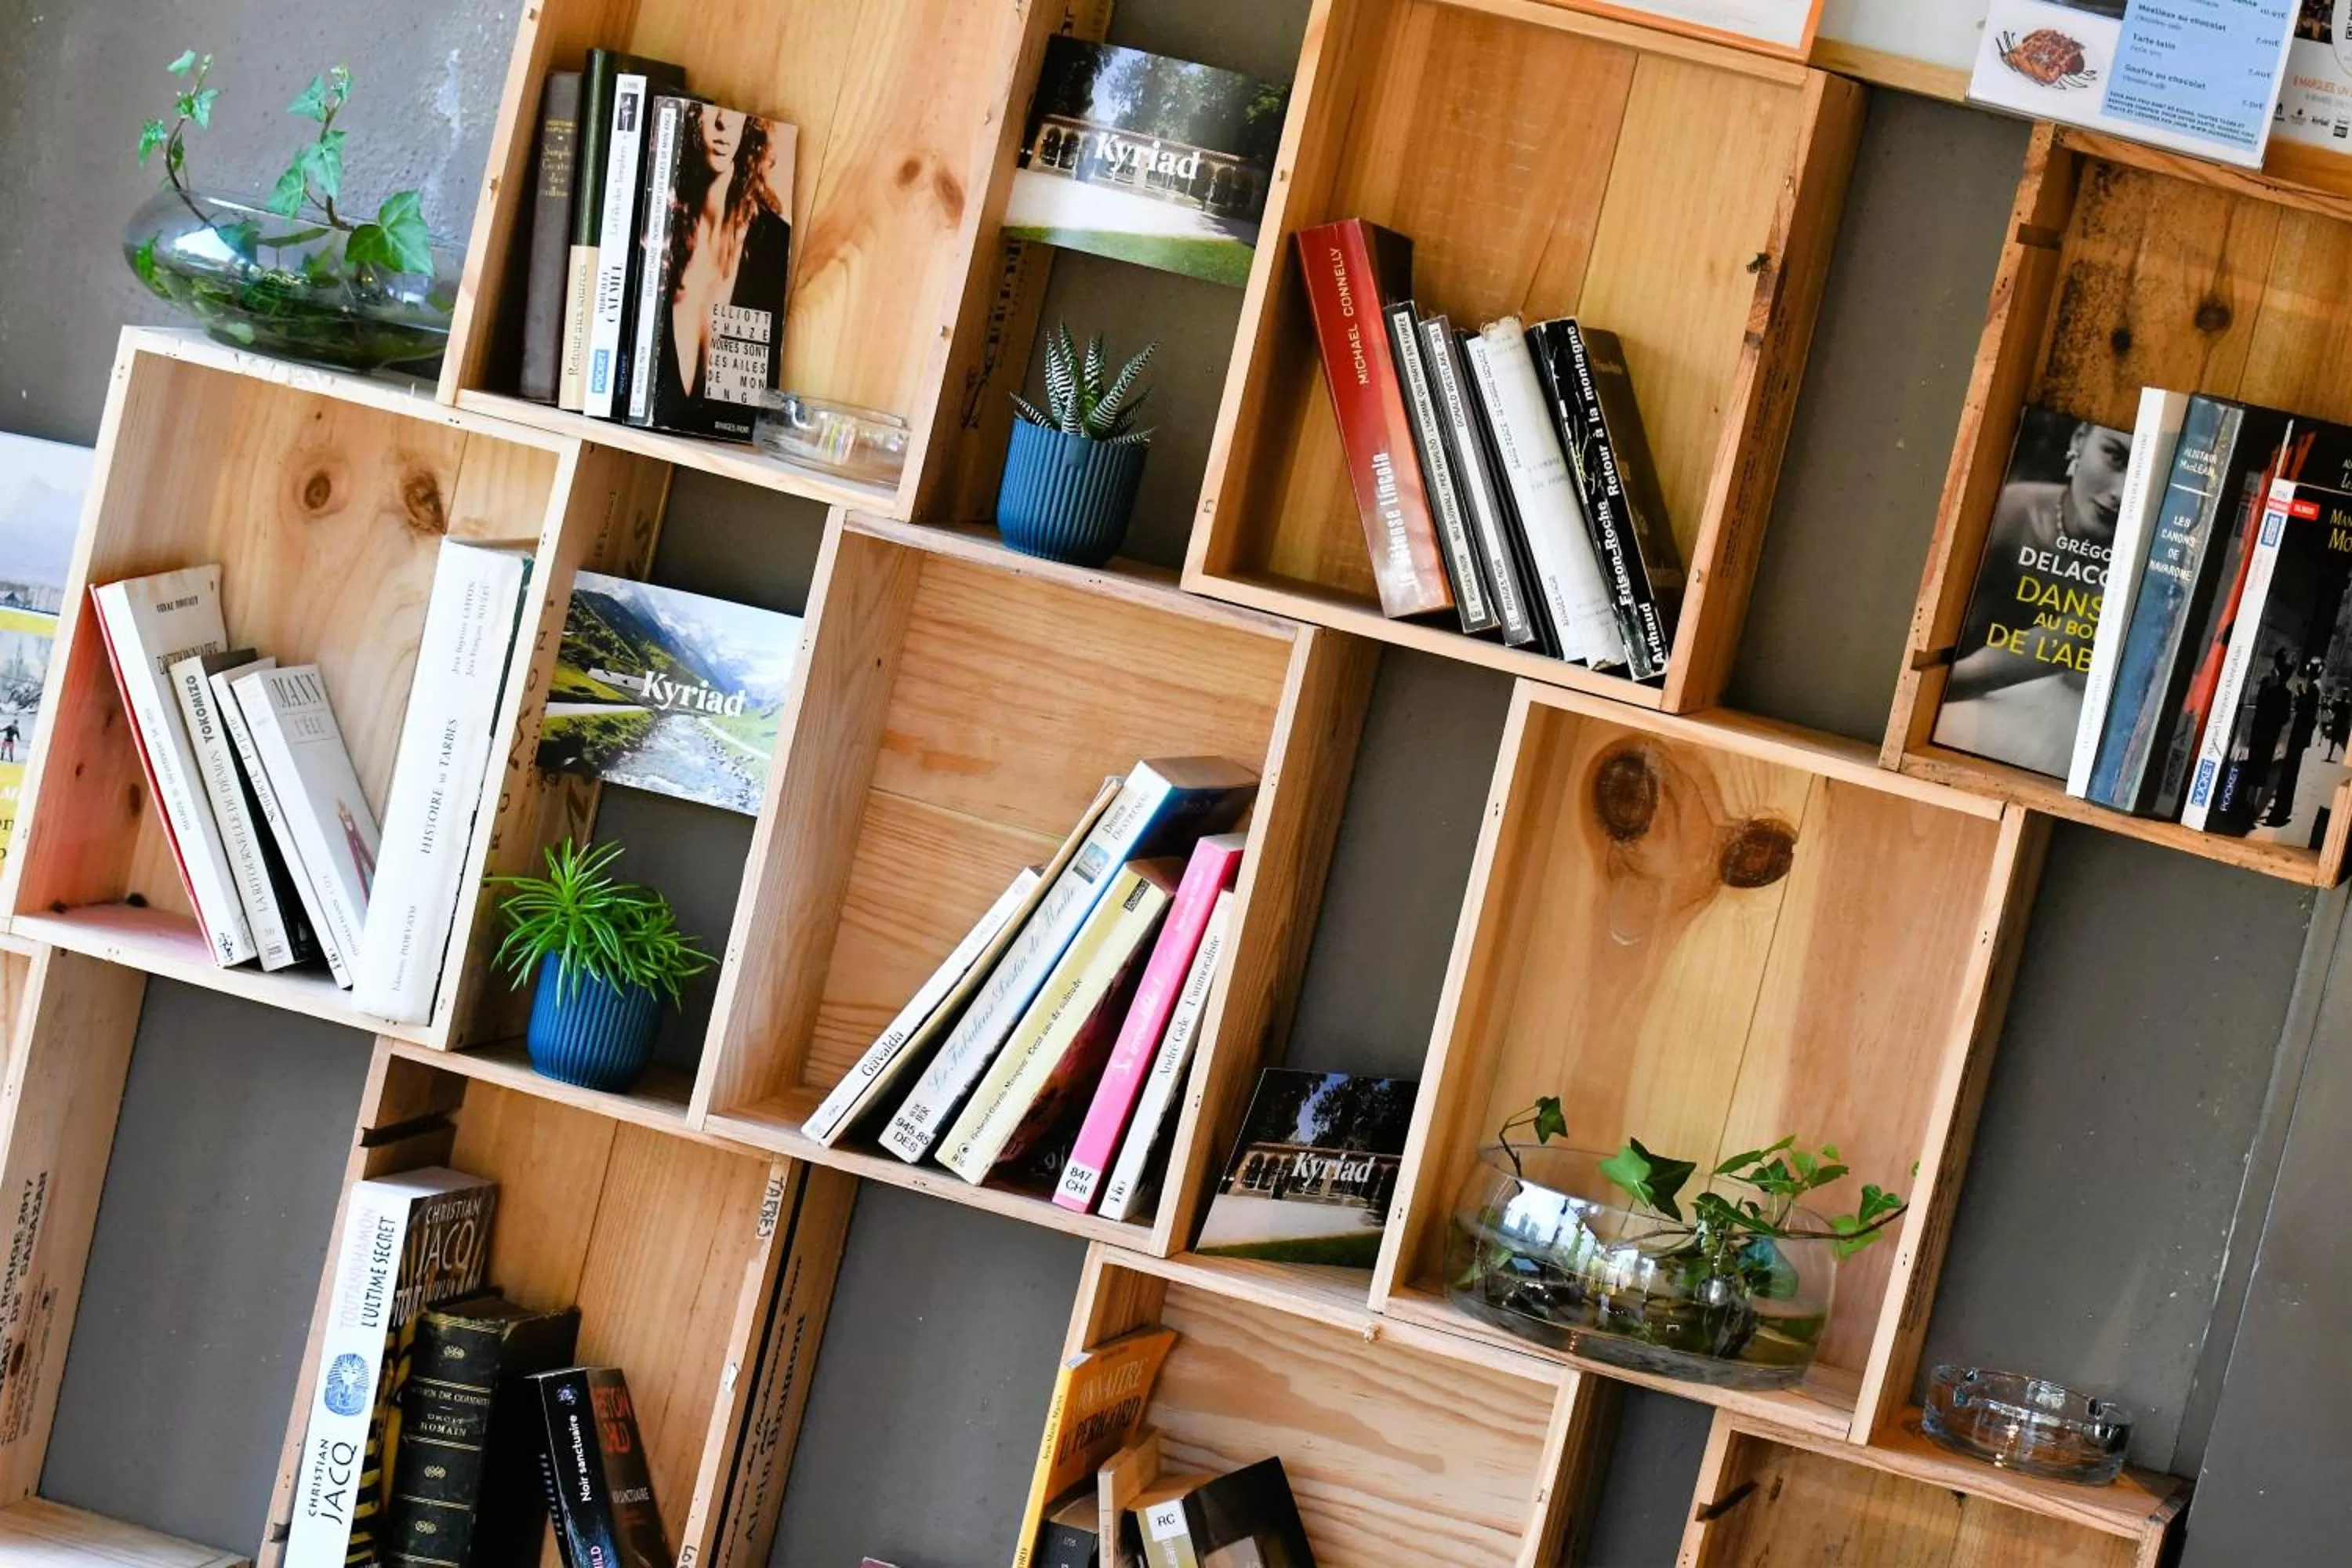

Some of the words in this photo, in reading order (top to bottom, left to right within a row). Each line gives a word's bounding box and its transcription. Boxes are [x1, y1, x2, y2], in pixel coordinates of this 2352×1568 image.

[1094, 132, 1200, 179] Kyriad
[1330, 246, 1354, 318] CONNELLY
[711, 320, 770, 341] CHAZE
[713, 303, 770, 325] ELLIOTT
[568, 335, 583, 376] Retour
[709, 355, 728, 368] LES
[732, 358, 766, 375] AILES
[711, 338, 740, 354] NOIRES
[743, 343, 768, 358] SONT
[1347, 324, 1369, 386] MICHAEL
[1566, 325, 1595, 401] montagne
[708, 370, 720, 383] DE
[740, 376, 766, 390] MON
[1438, 350, 1455, 393] WESTLAKE
[1584, 405, 1600, 423] la
[1591, 426, 1604, 439] à
[1595, 443, 1620, 496] Retour
[2161, 528, 2196, 548] CANONS
[2172, 514, 2191, 528] LES
[2149, 560, 2193, 582] NAVARONE
[2167, 548, 2180, 561] DE
[1638, 601, 1664, 664] Arthaud
[1986, 622, 2031, 655] DE
[2033, 612, 2062, 631] AU
[2065, 619, 2096, 641] BO
[270, 673, 323, 708] MANN
[640, 670, 746, 717] Kyriad
[185, 675, 215, 745] YOKOMIZO
[417, 788, 446, 854] HISTOIRE
[436, 716, 461, 768] TARBES
[2191, 758, 2217, 808] POCKET
[2219, 766, 2240, 812] POCKET
[861, 1029, 906, 1079] Gavalda
[891, 1130, 920, 1154] DES
[893, 1116, 933, 1146] 945.85
[1064, 1178, 1087, 1195] CHI
[1069, 1166, 1092, 1181] 847
[1291, 1152, 1375, 1188] Kyriad
[426, 1198, 482, 1225] CHRISTIAN
[757, 1176, 785, 1237] TARBES
[374, 1216, 396, 1266] SECRET
[416, 1220, 475, 1279] JACQ
[9, 1291, 24, 1323] DE
[361, 1265, 388, 1328] L'ULTIME
[568, 1414, 587, 1475] sanctuaire
[308, 1439, 329, 1517] CHRISTIAN
[320, 1442, 358, 1525] JACQ
[579, 1476, 592, 1502] Noir
[1157, 1512, 1176, 1527] RC
